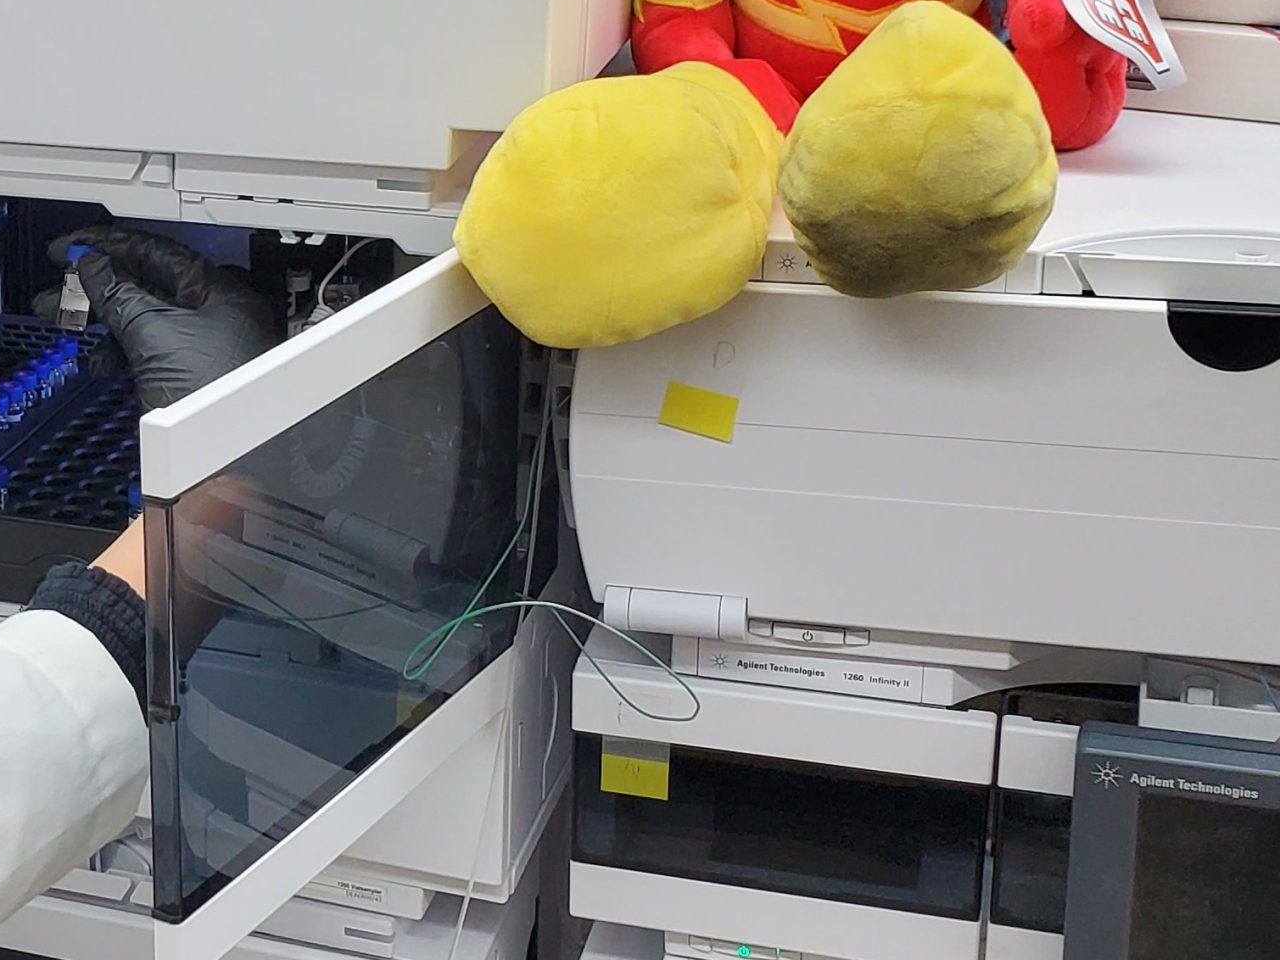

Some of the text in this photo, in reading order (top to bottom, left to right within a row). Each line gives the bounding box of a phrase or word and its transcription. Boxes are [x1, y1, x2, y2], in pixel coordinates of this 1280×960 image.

[737, 659, 768, 671] Agilent
[770, 662, 825, 678] Technologies
[843, 672, 864, 682] 1260
[869, 675, 901, 688] Infinity
[1130, 772, 1259, 800] Agilent Technologies
